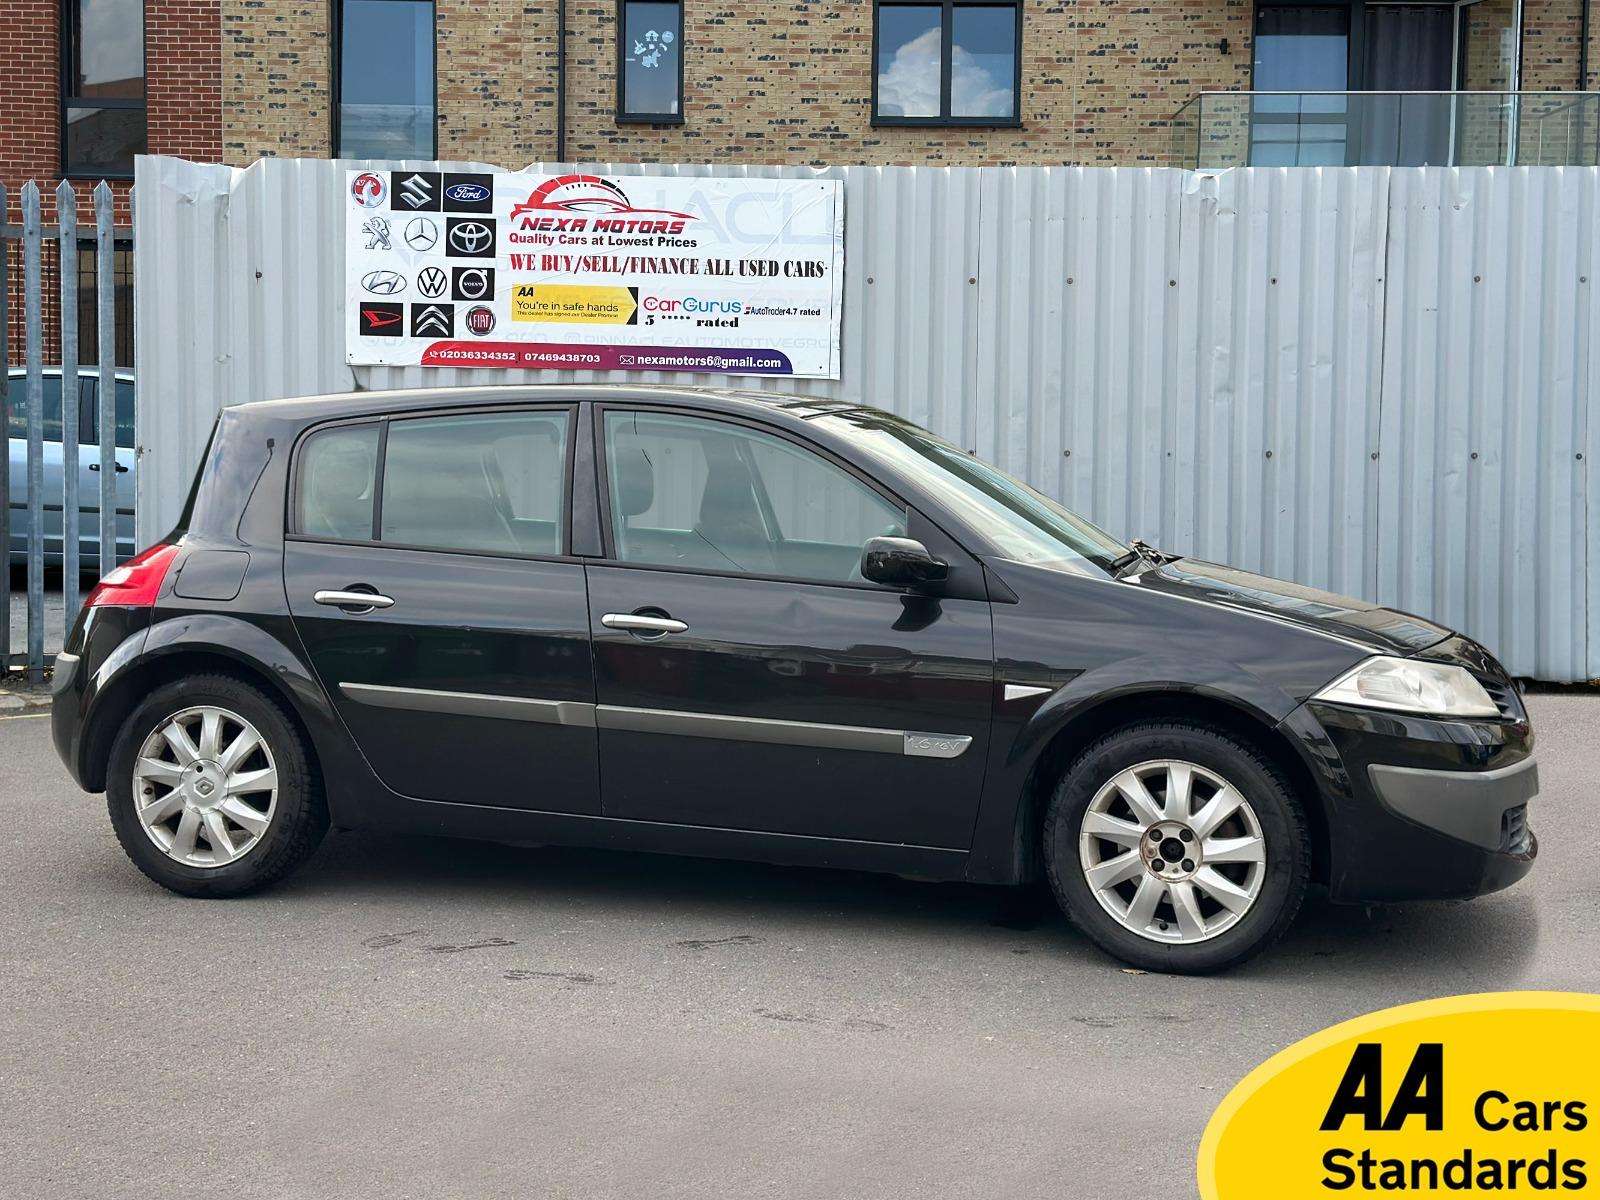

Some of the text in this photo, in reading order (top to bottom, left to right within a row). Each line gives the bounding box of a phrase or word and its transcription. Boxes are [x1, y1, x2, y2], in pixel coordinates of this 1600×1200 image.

[454, 187, 481, 199] Ford
[519, 216, 686, 235] NEXA MOTORS
[509, 232, 698, 248] Quality Cars at Lowest Prices
[510, 253, 536, 271] WE
[541, 254, 699, 276] BUY/SELL/FINANCE
[703, 258, 734, 276] ALL
[738, 260, 780, 277] USED
[517, 286, 534, 297] AA
[516, 300, 619, 313] You're in safe hands
[643, 296, 743, 314] CarGurus
[799, 308, 821, 317] rated
[473, 314, 490, 328] FIAT
[644, 314, 739, 328] 5 rated
[440, 350, 601, 363] 02036334352 07469438703
[637, 354, 782, 369] nexamotors6@gmail.com
